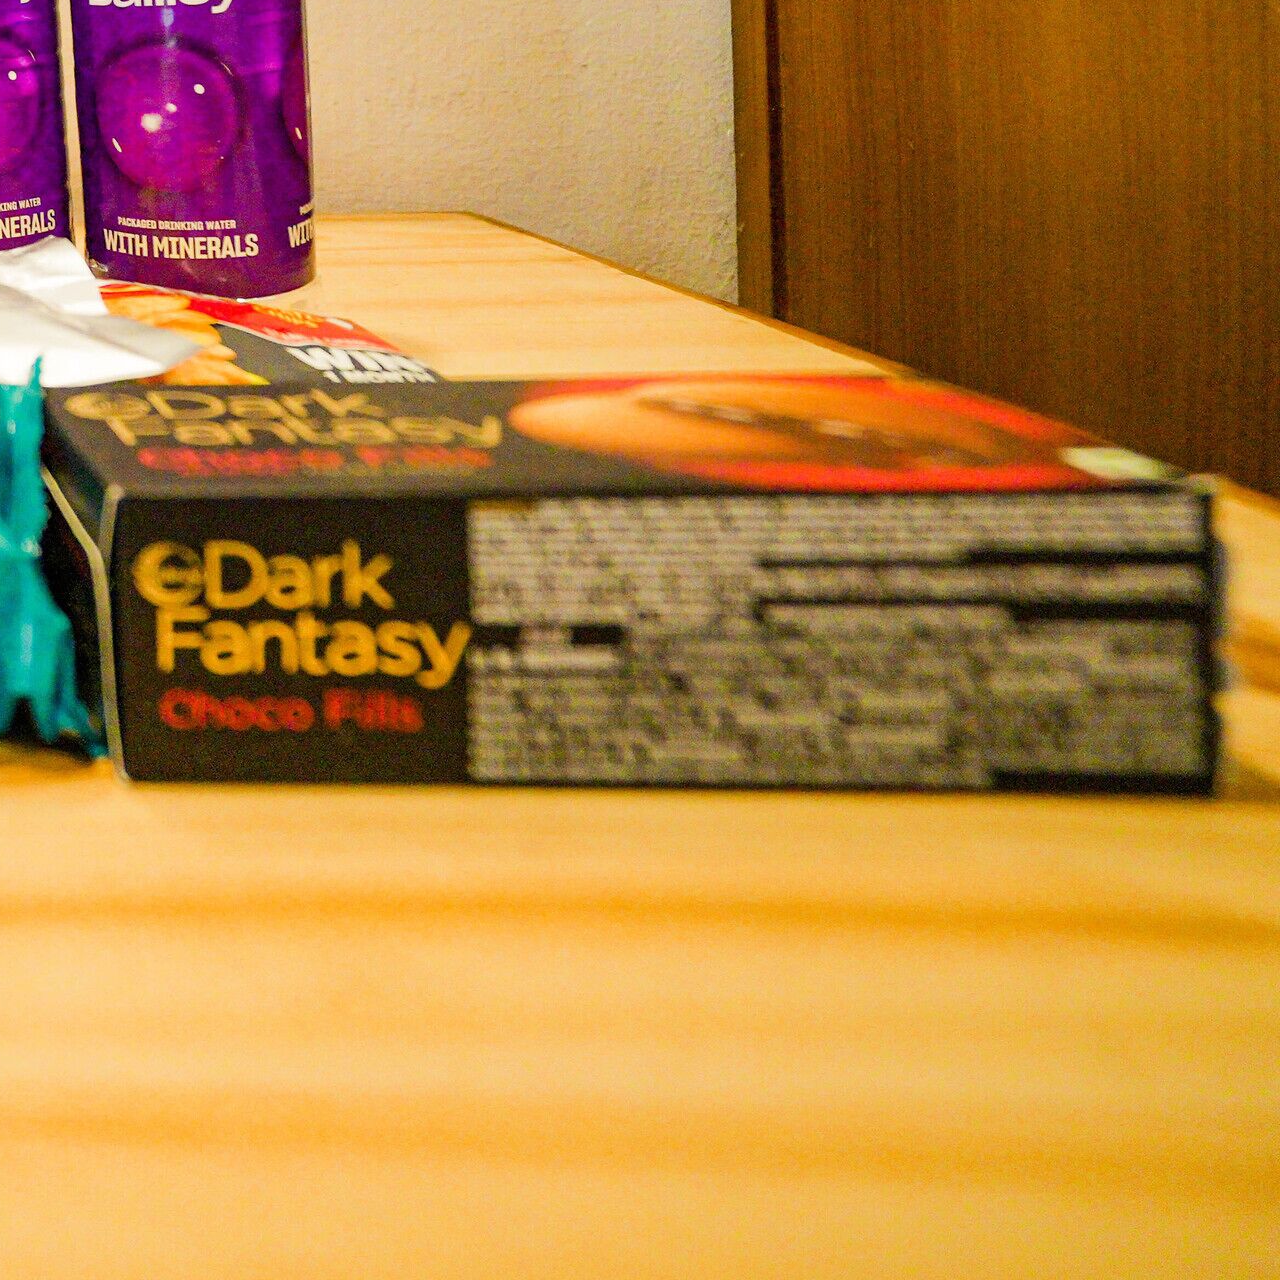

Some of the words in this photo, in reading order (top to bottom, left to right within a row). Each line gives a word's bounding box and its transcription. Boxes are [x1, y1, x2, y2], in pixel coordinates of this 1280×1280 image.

[19, 197, 41, 210] WATER
[117, 216, 157, 229] PACKAGED
[158, 220, 204, 231] DRINKING
[205, 219, 237, 231] WATER
[103, 228, 148, 257] WITH
[153, 233, 259, 260] MINERALS
[147, 388, 385, 421] Dark
[110, 415, 503, 449] Fantasy
[202, 538, 395, 610] Dark
[154, 604, 473, 690] Fantasy
[157, 686, 316, 732] Choco
[322, 686, 425, 734] Fills
